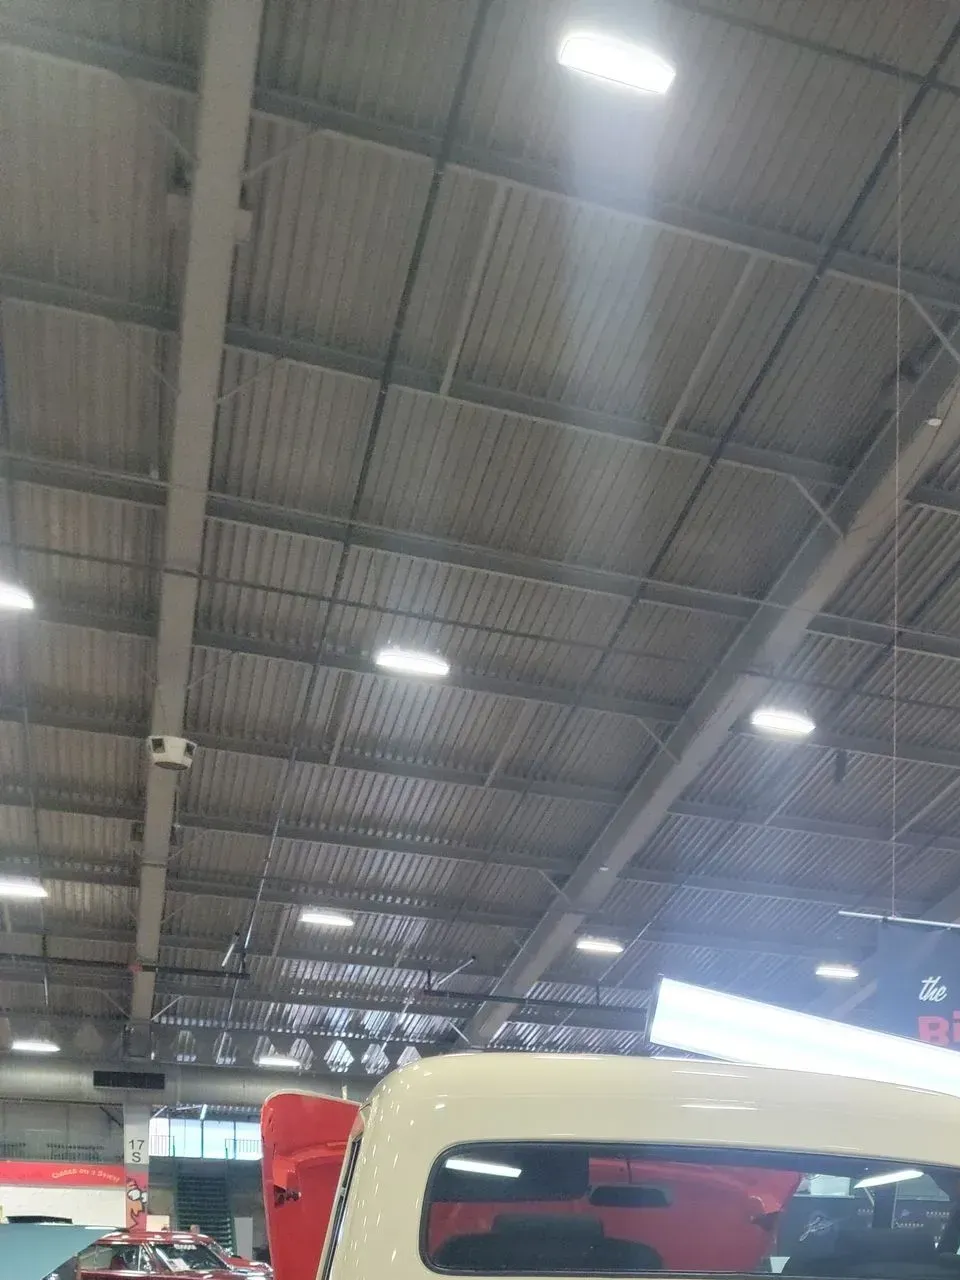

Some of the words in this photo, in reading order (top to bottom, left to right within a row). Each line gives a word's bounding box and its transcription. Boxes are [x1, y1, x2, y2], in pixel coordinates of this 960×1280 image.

[918, 975, 948, 1003] the
[128, 1139, 145, 1151] 17
[131, 1151, 142, 1163] S
